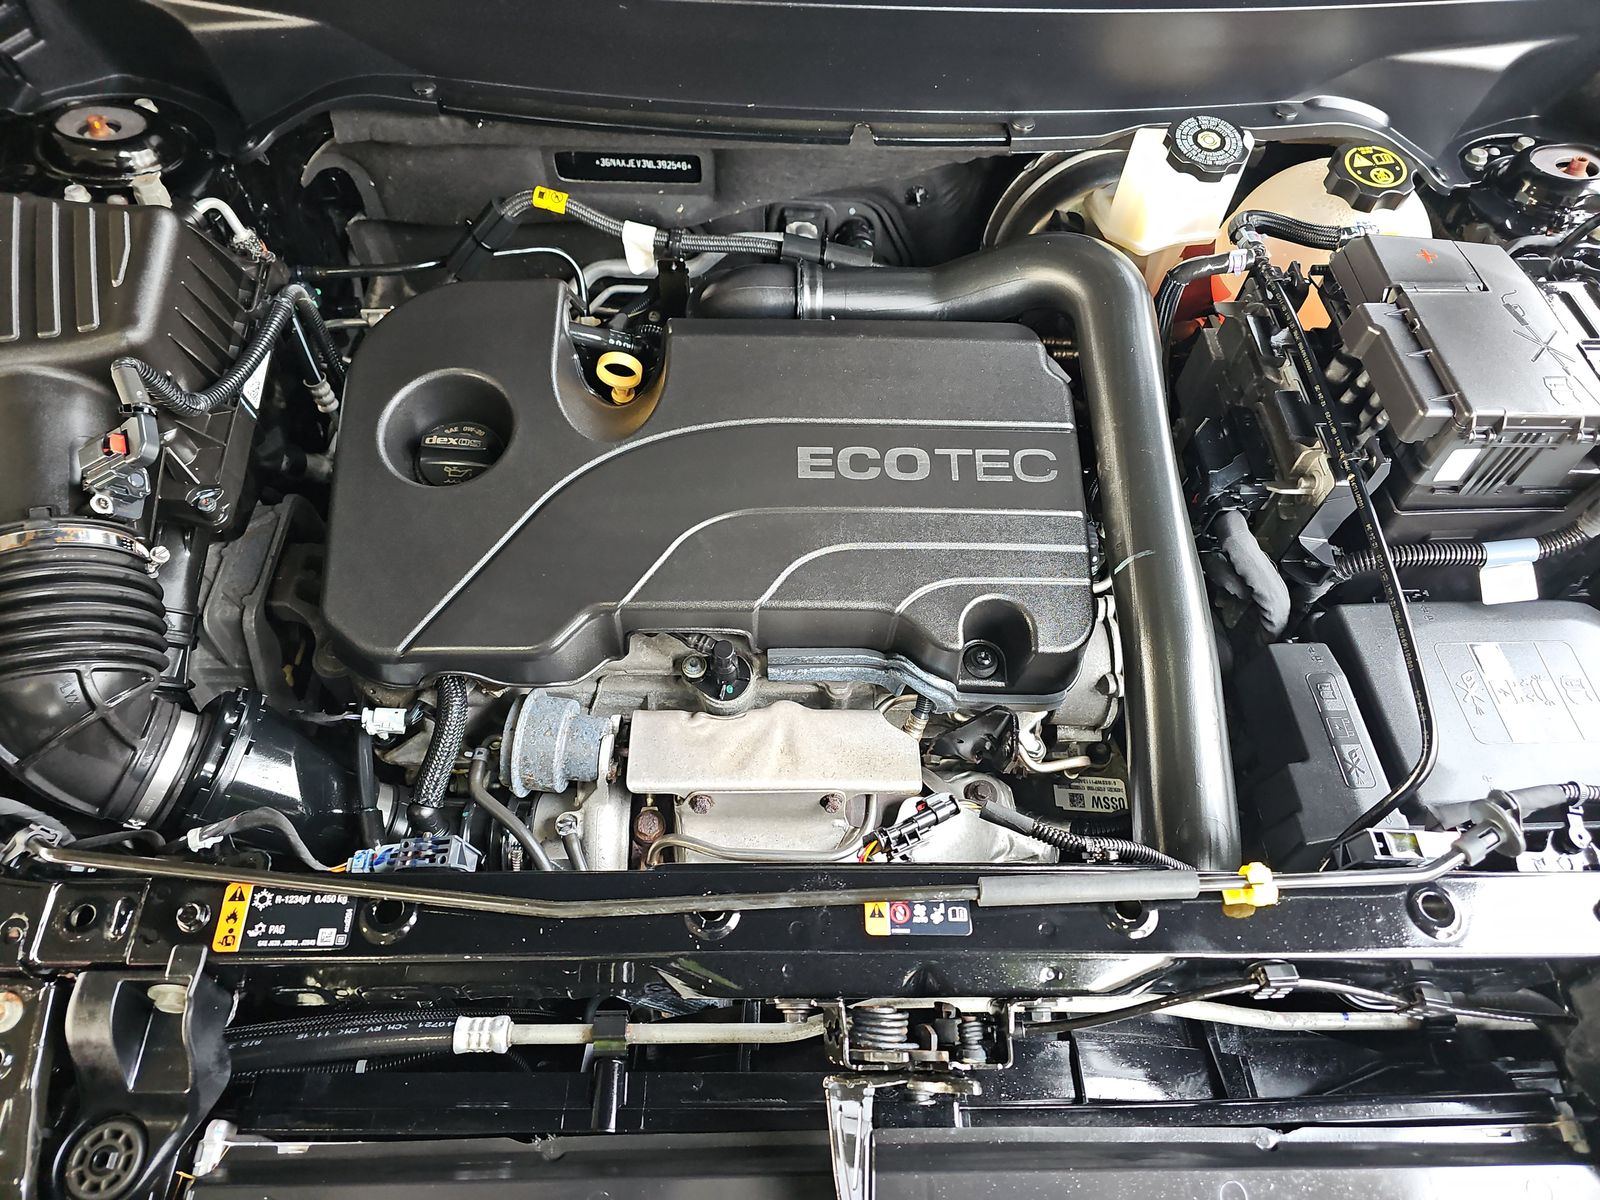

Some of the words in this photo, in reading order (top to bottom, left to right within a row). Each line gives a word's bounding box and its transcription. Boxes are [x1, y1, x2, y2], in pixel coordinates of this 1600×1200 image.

[797, 446, 1059, 483] ECOTEC
[274, 894, 311, 905] R-1234yf
[314, 894, 336, 904] 0.450
[337, 894, 348, 905] kg
[268, 924, 286, 935] PAG
